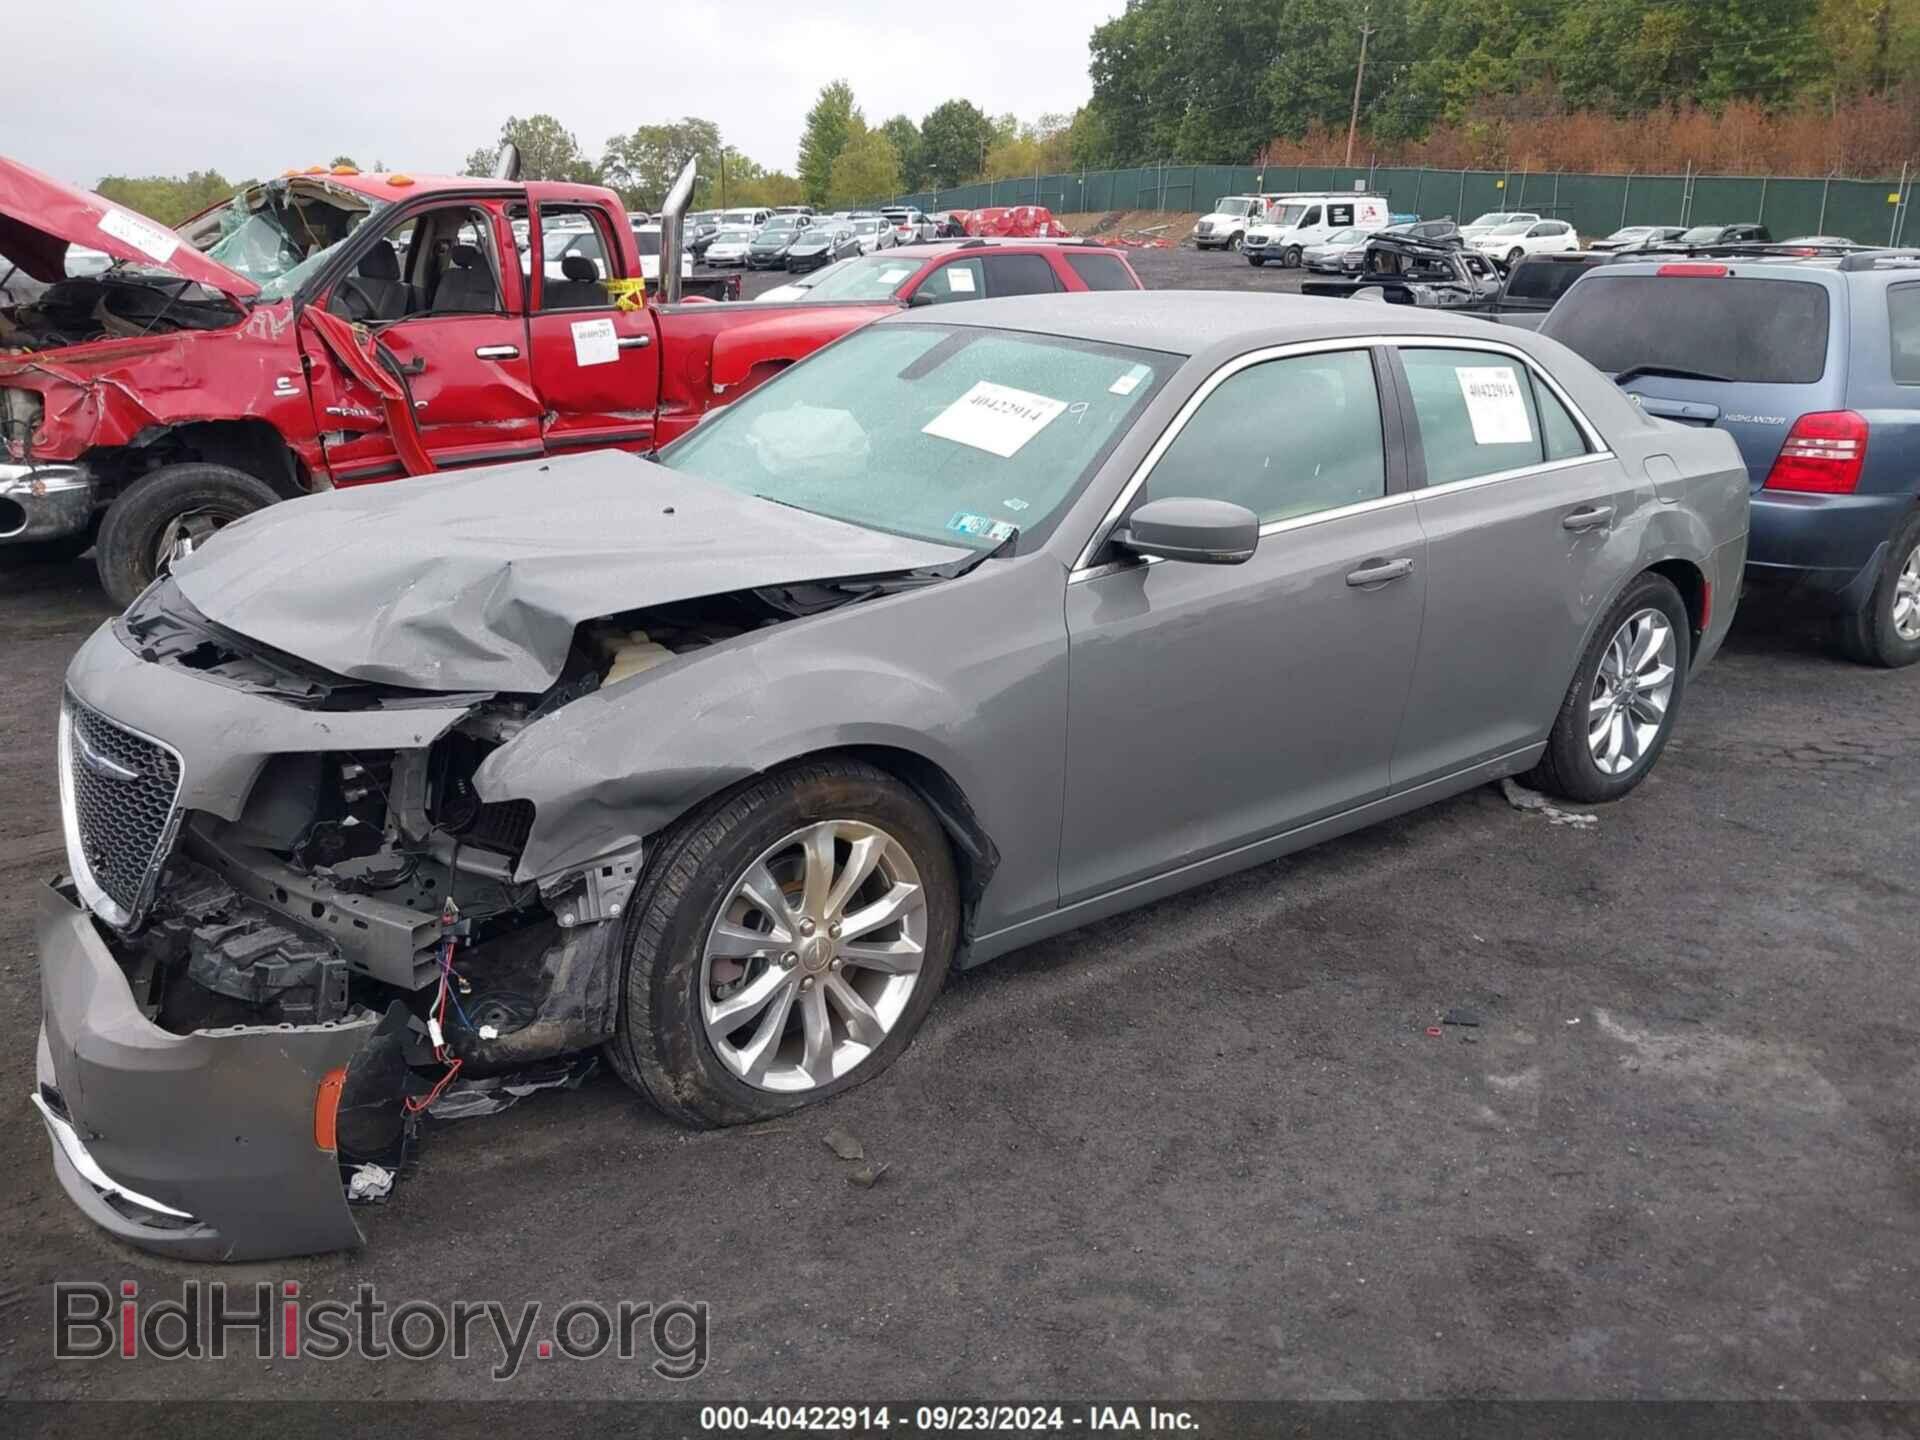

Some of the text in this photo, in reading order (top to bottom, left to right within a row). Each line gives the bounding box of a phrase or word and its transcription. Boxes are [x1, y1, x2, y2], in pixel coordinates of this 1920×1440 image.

[1470, 383, 1515, 398] 40422914
[969, 395, 1043, 422] 40422914
[1725, 414, 1786, 425] HIGHLANDER
